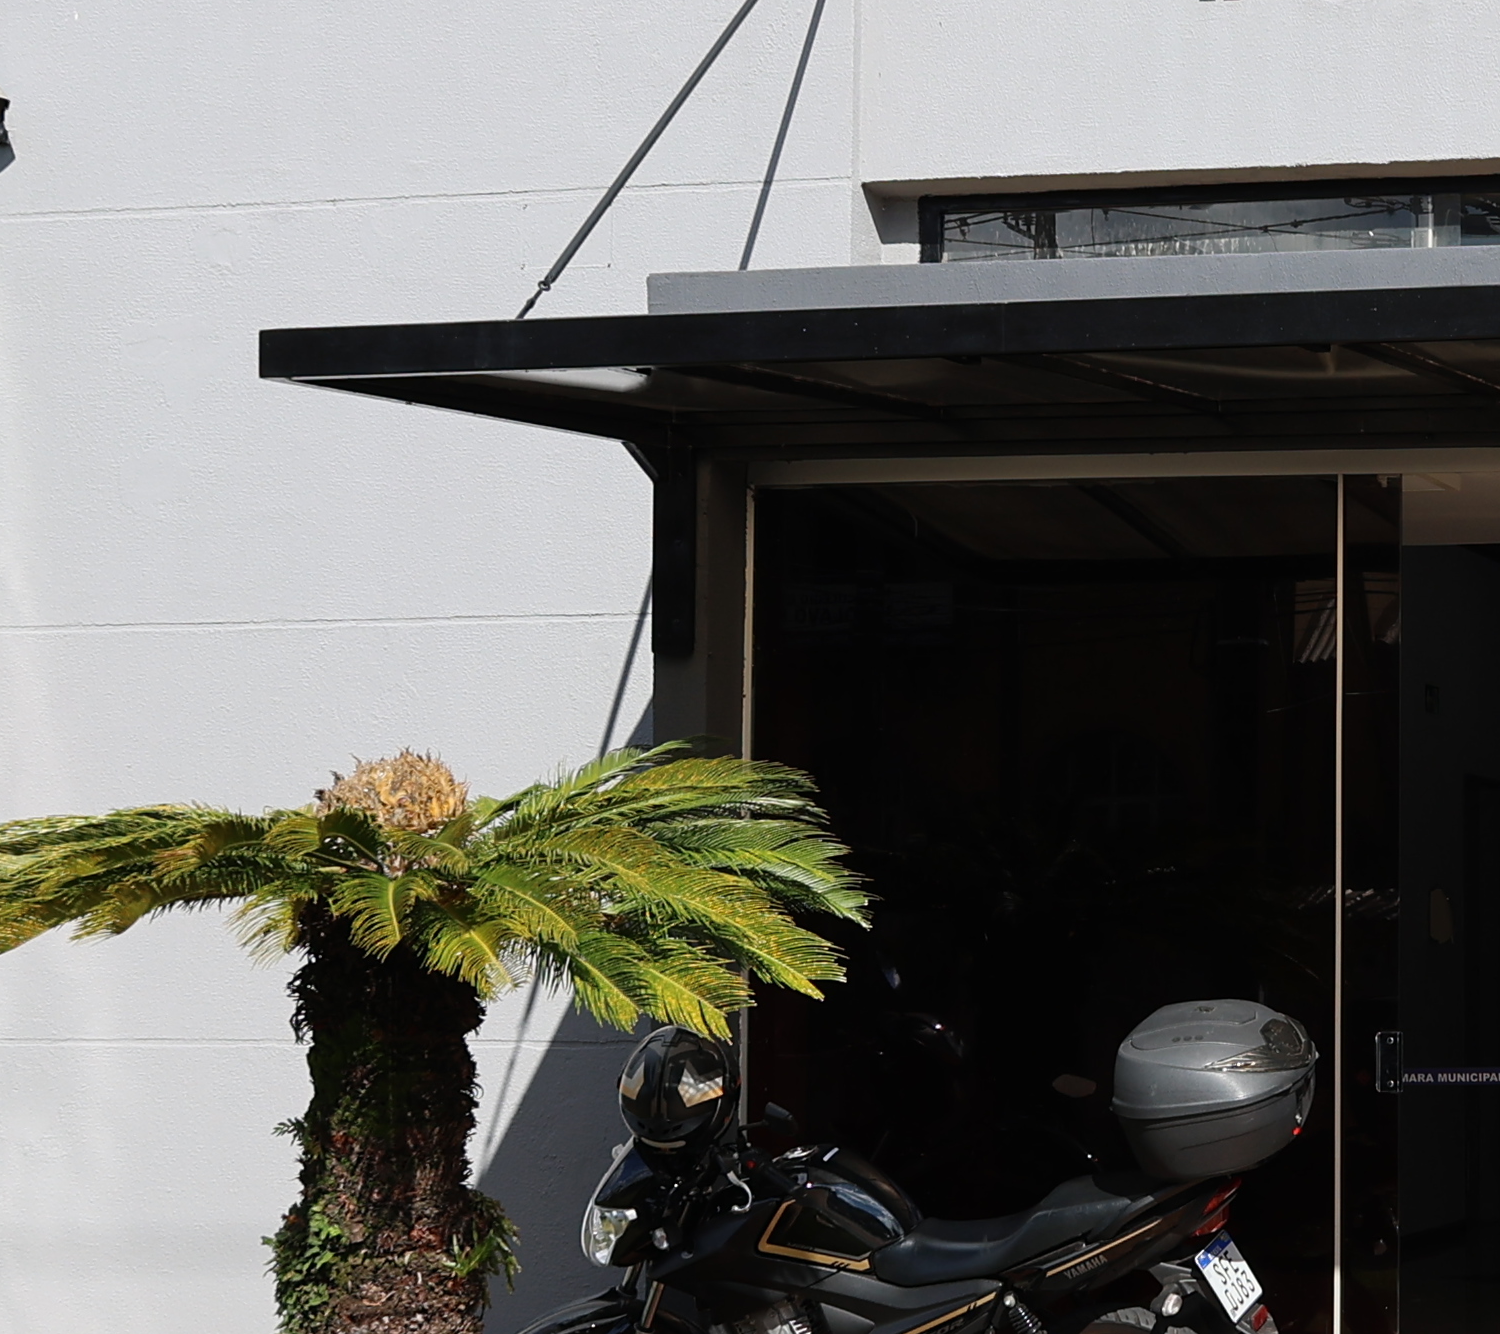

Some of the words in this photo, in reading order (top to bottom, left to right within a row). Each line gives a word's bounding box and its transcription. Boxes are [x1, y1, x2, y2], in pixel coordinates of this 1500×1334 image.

[1402, 1072, 1434, 1083] MARA
[1063, 1254, 1108, 1279] YAMAHA
[1213, 1250, 1239, 1285] SFE
